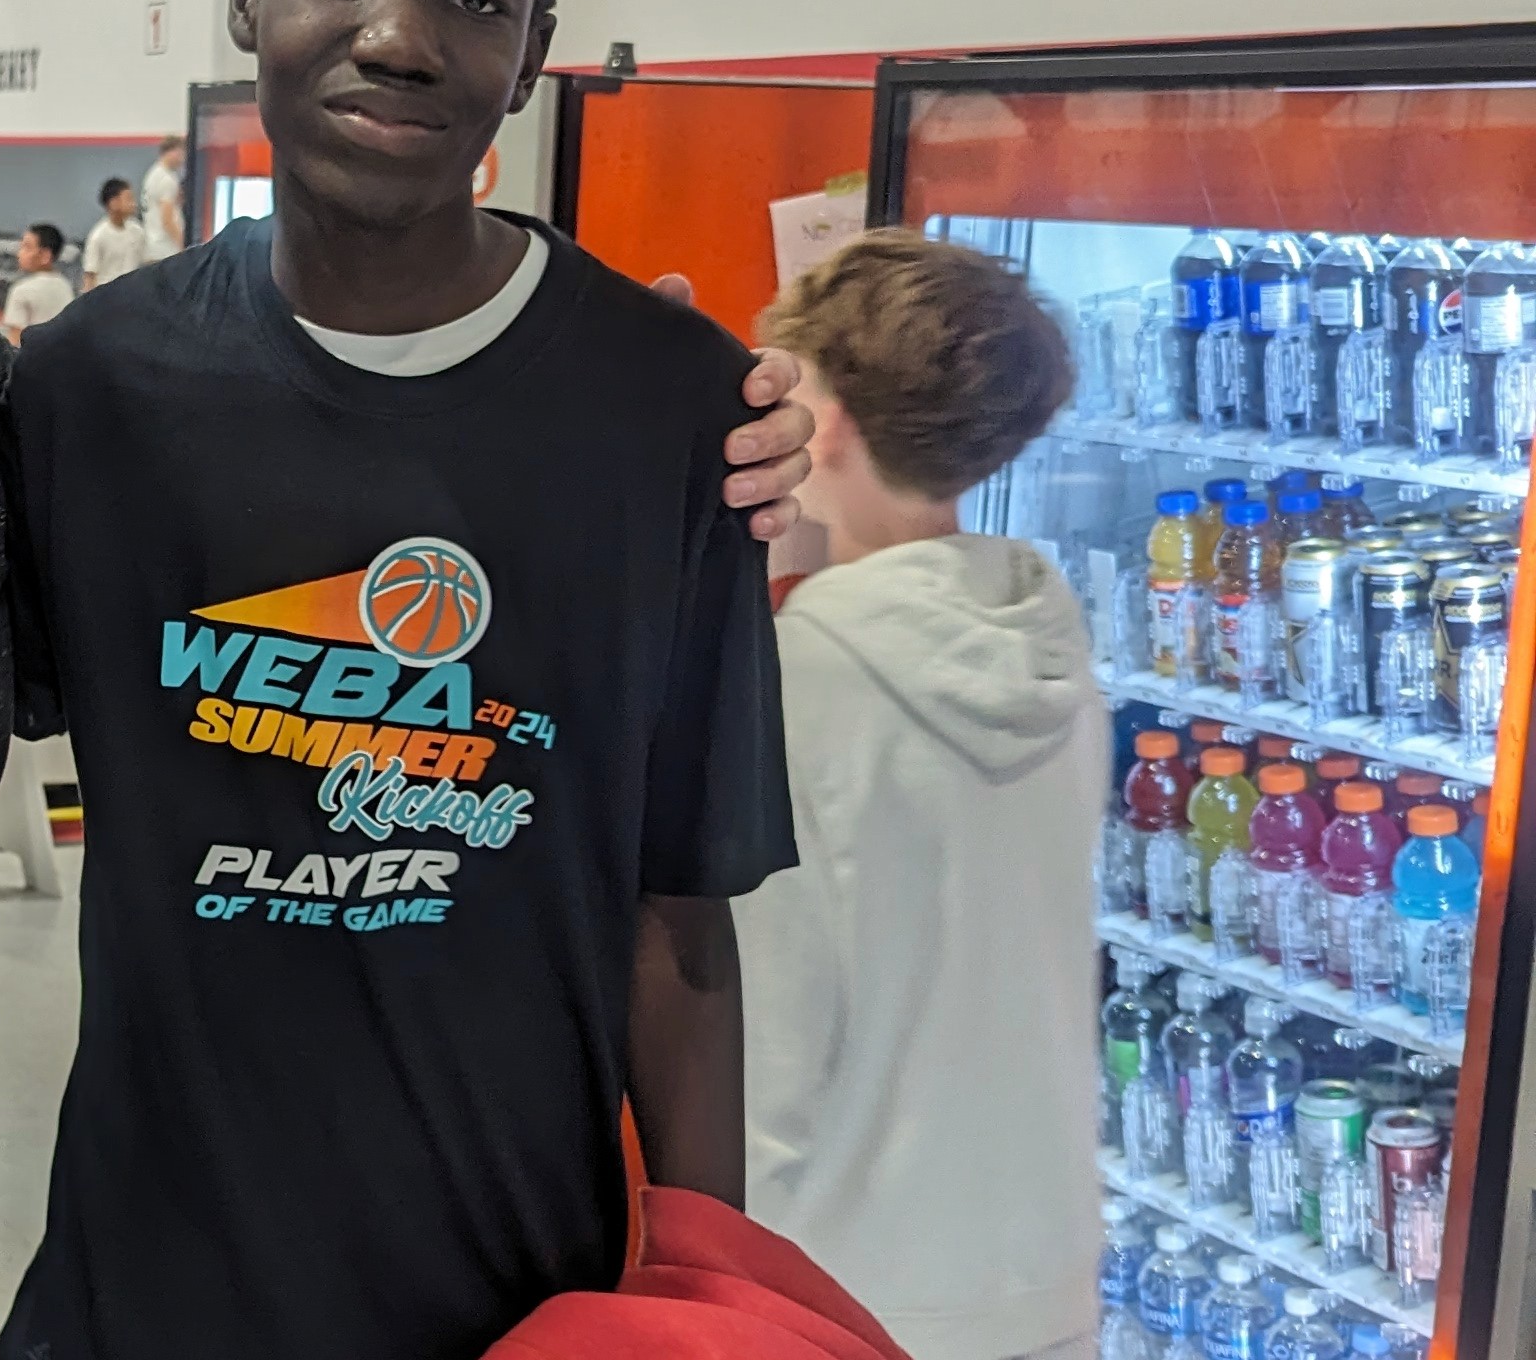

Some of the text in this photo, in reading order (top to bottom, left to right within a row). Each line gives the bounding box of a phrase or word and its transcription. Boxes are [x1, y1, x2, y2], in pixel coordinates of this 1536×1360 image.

[161, 621, 473, 730] WEBA
[189, 698, 498, 782] SUMMER
[318, 750, 534, 850] Kickoff
[194, 844, 461, 898] PLAYER
[195, 894, 455, 931] OF THE GAME
